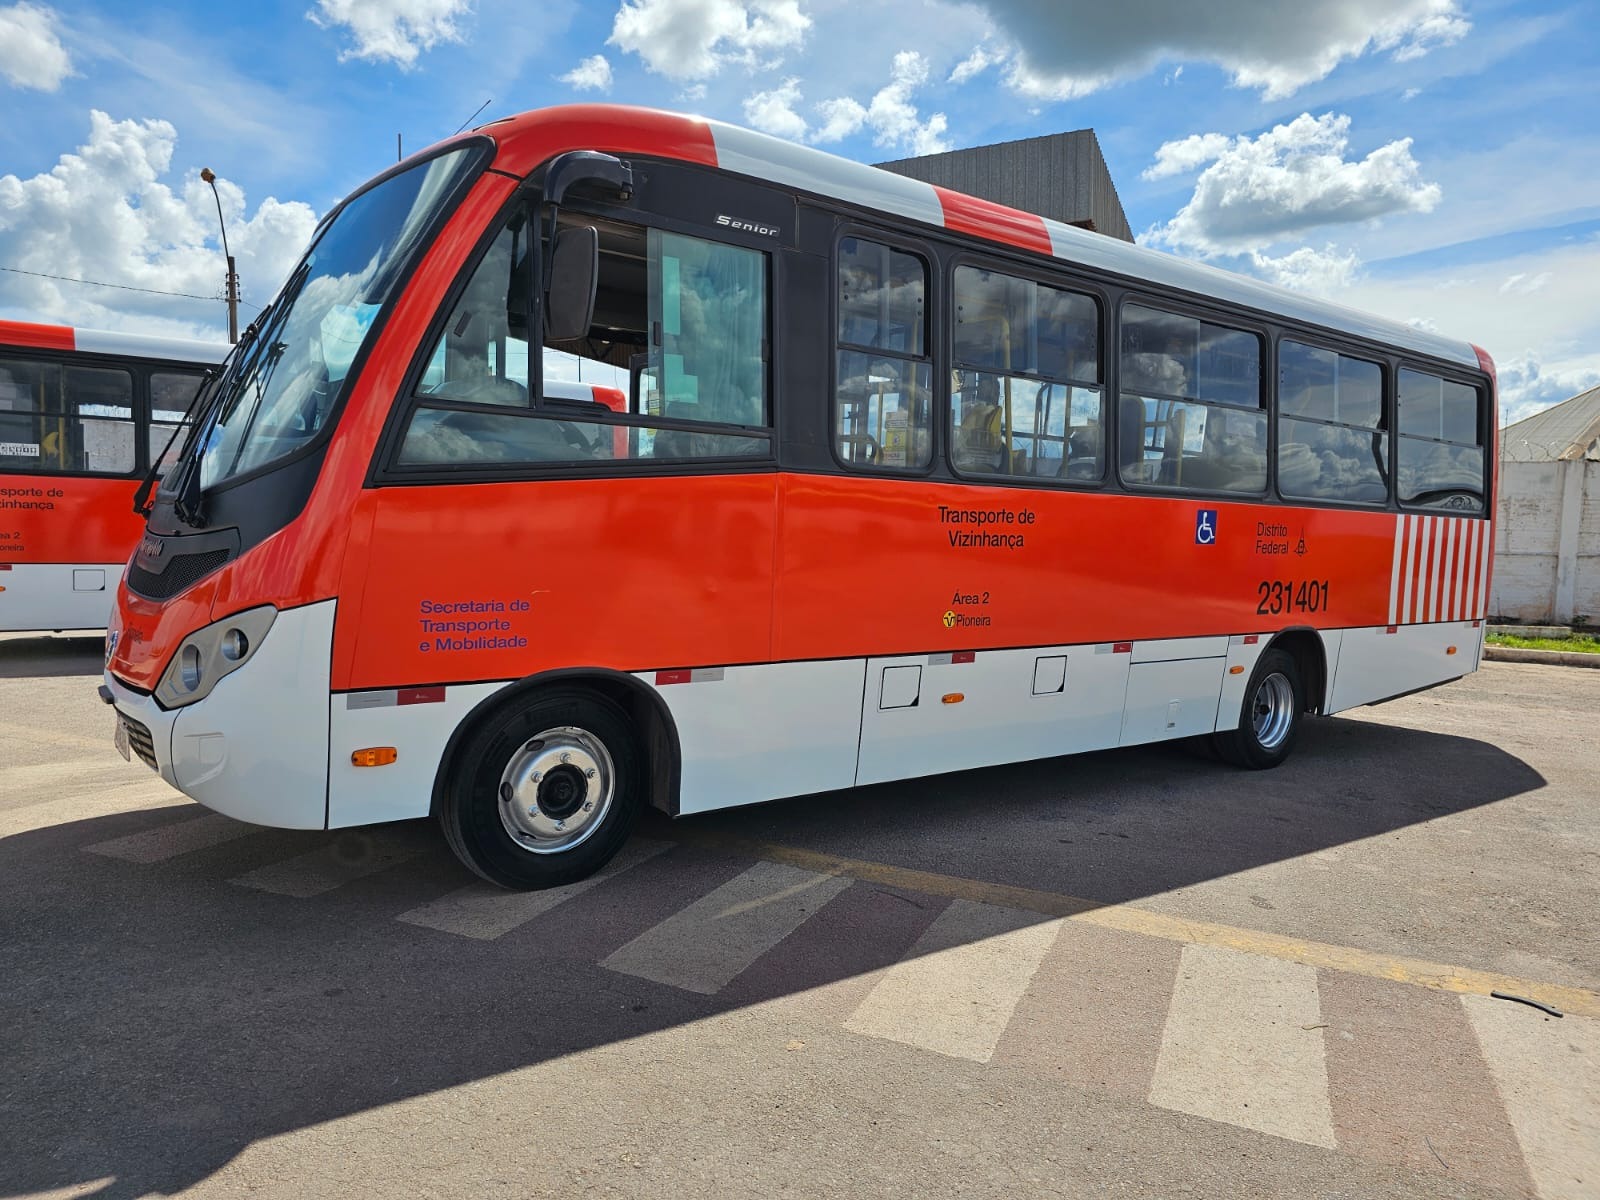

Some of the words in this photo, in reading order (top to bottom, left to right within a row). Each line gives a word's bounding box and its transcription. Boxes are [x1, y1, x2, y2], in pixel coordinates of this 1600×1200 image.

[716, 215, 777, 236] Senior
[47, 488, 64, 498] de
[938, 506, 1014, 526] Transporte
[1018, 508, 1035, 524] de
[13, 531, 21, 539] 2
[1257, 522, 1288, 537] Distrito
[948, 530, 1024, 550] Vizinhança
[1256, 540, 1289, 555] Federal
[952, 589, 979, 605] Área
[982, 591, 990, 604] 2
[1256, 580, 1329, 615] 231401
[420, 600, 505, 614] Secretaria
[509, 599, 530, 612] de
[420, 618, 511, 633] Transporte
[956, 613, 991, 627] Pioneira
[419, 641, 431, 652] e
[435, 635, 528, 651] Mobilidade
